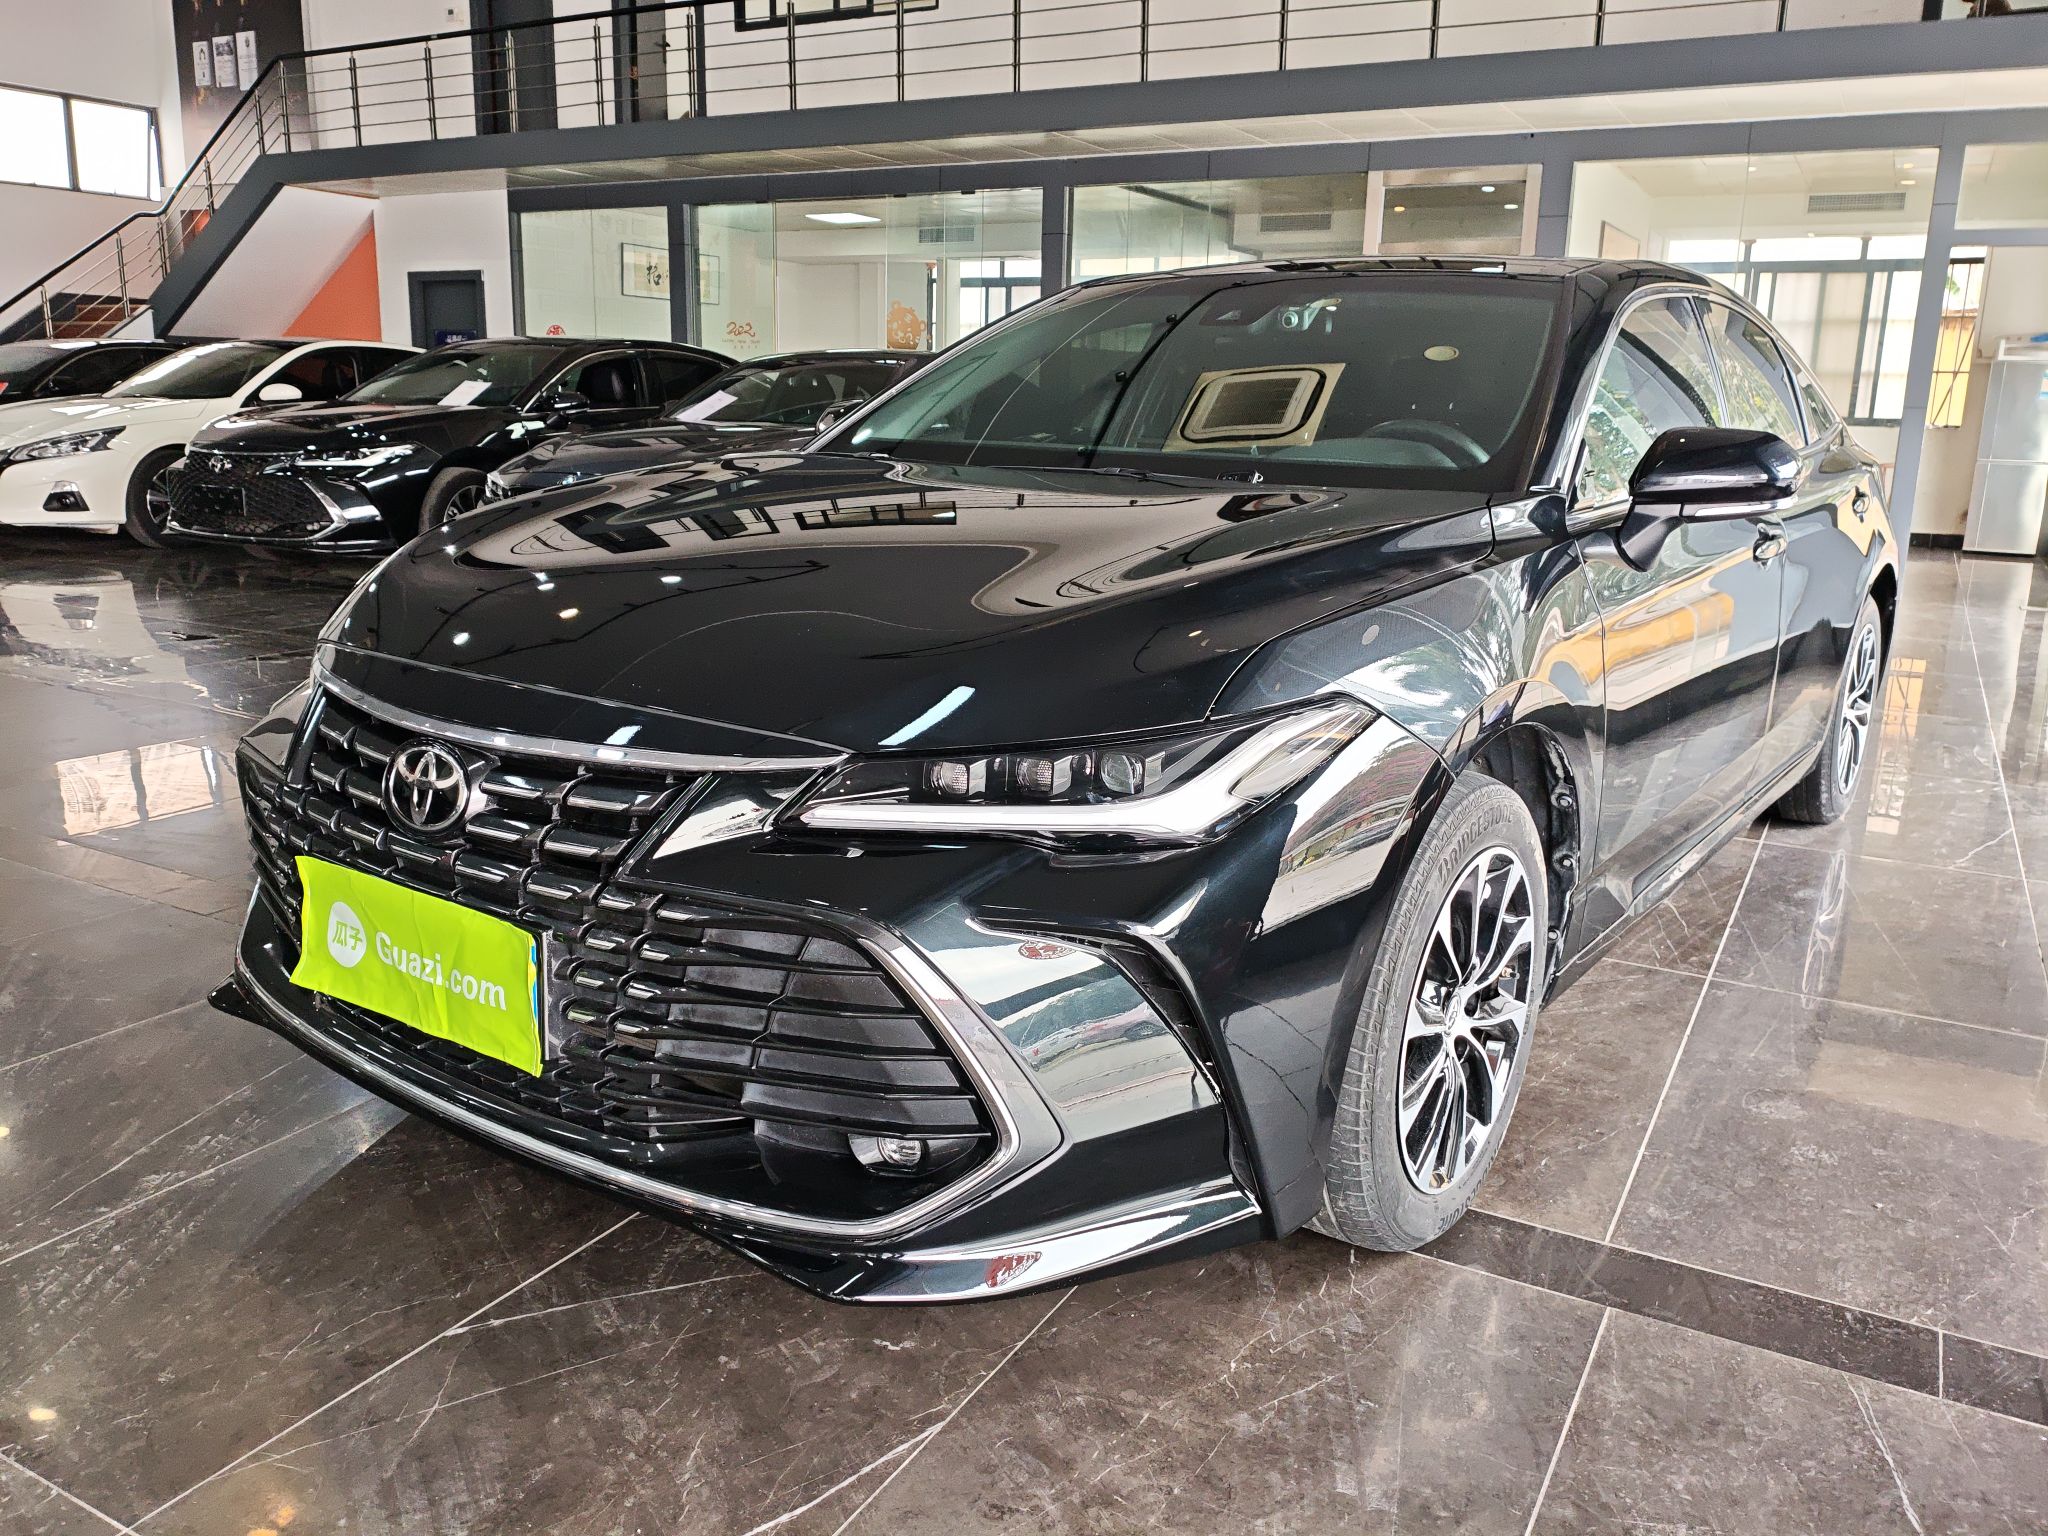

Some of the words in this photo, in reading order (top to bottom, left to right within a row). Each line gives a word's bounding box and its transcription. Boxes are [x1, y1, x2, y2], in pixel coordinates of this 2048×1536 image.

[1437, 804, 1514, 888] BRIDGESTONE
[332, 920, 363, 951] 瓜子
[375, 931, 507, 1011] Guazi.com
